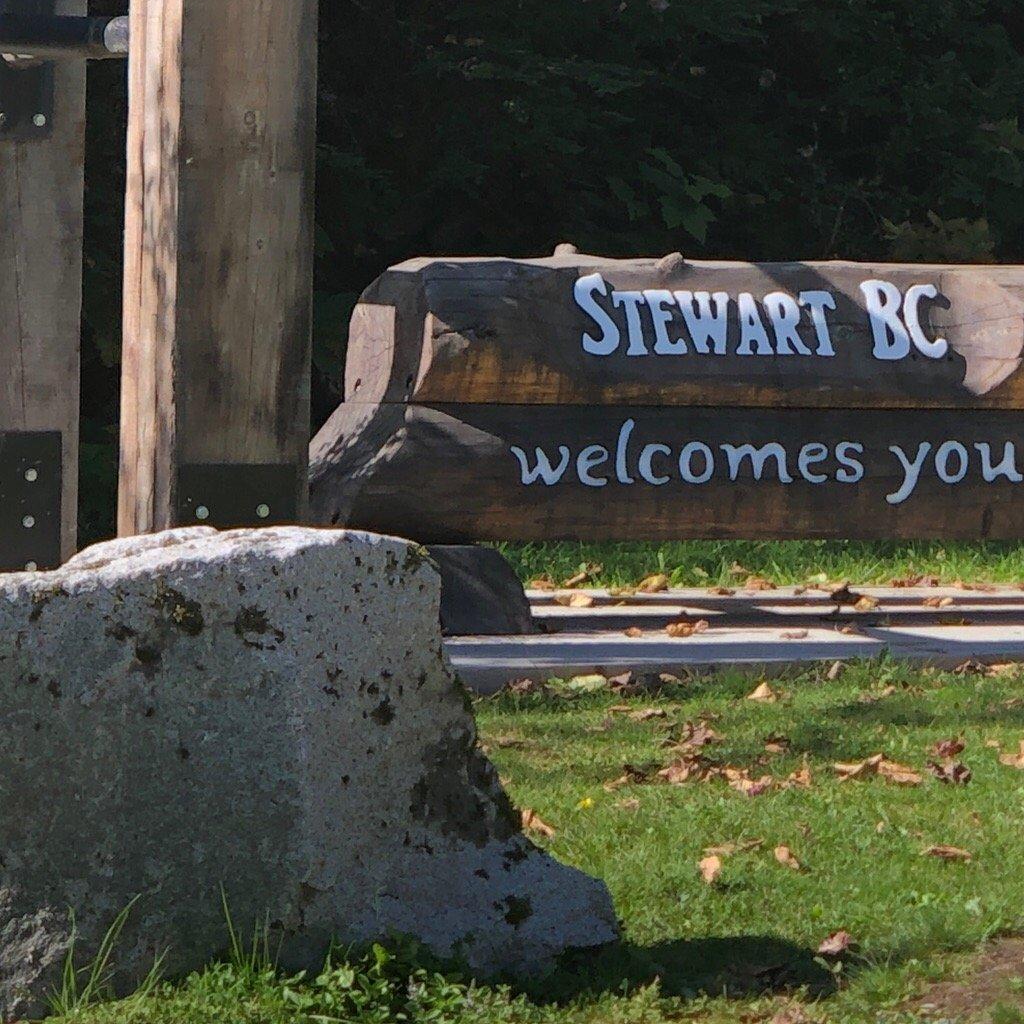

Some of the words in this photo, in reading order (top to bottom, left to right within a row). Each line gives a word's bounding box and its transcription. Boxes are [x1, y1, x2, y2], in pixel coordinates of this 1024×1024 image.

[574, 272, 836, 356] STEWART
[860, 280, 948, 360] BC
[510, 419, 864, 486] welcomes
[886, 439, 1023, 504] you
